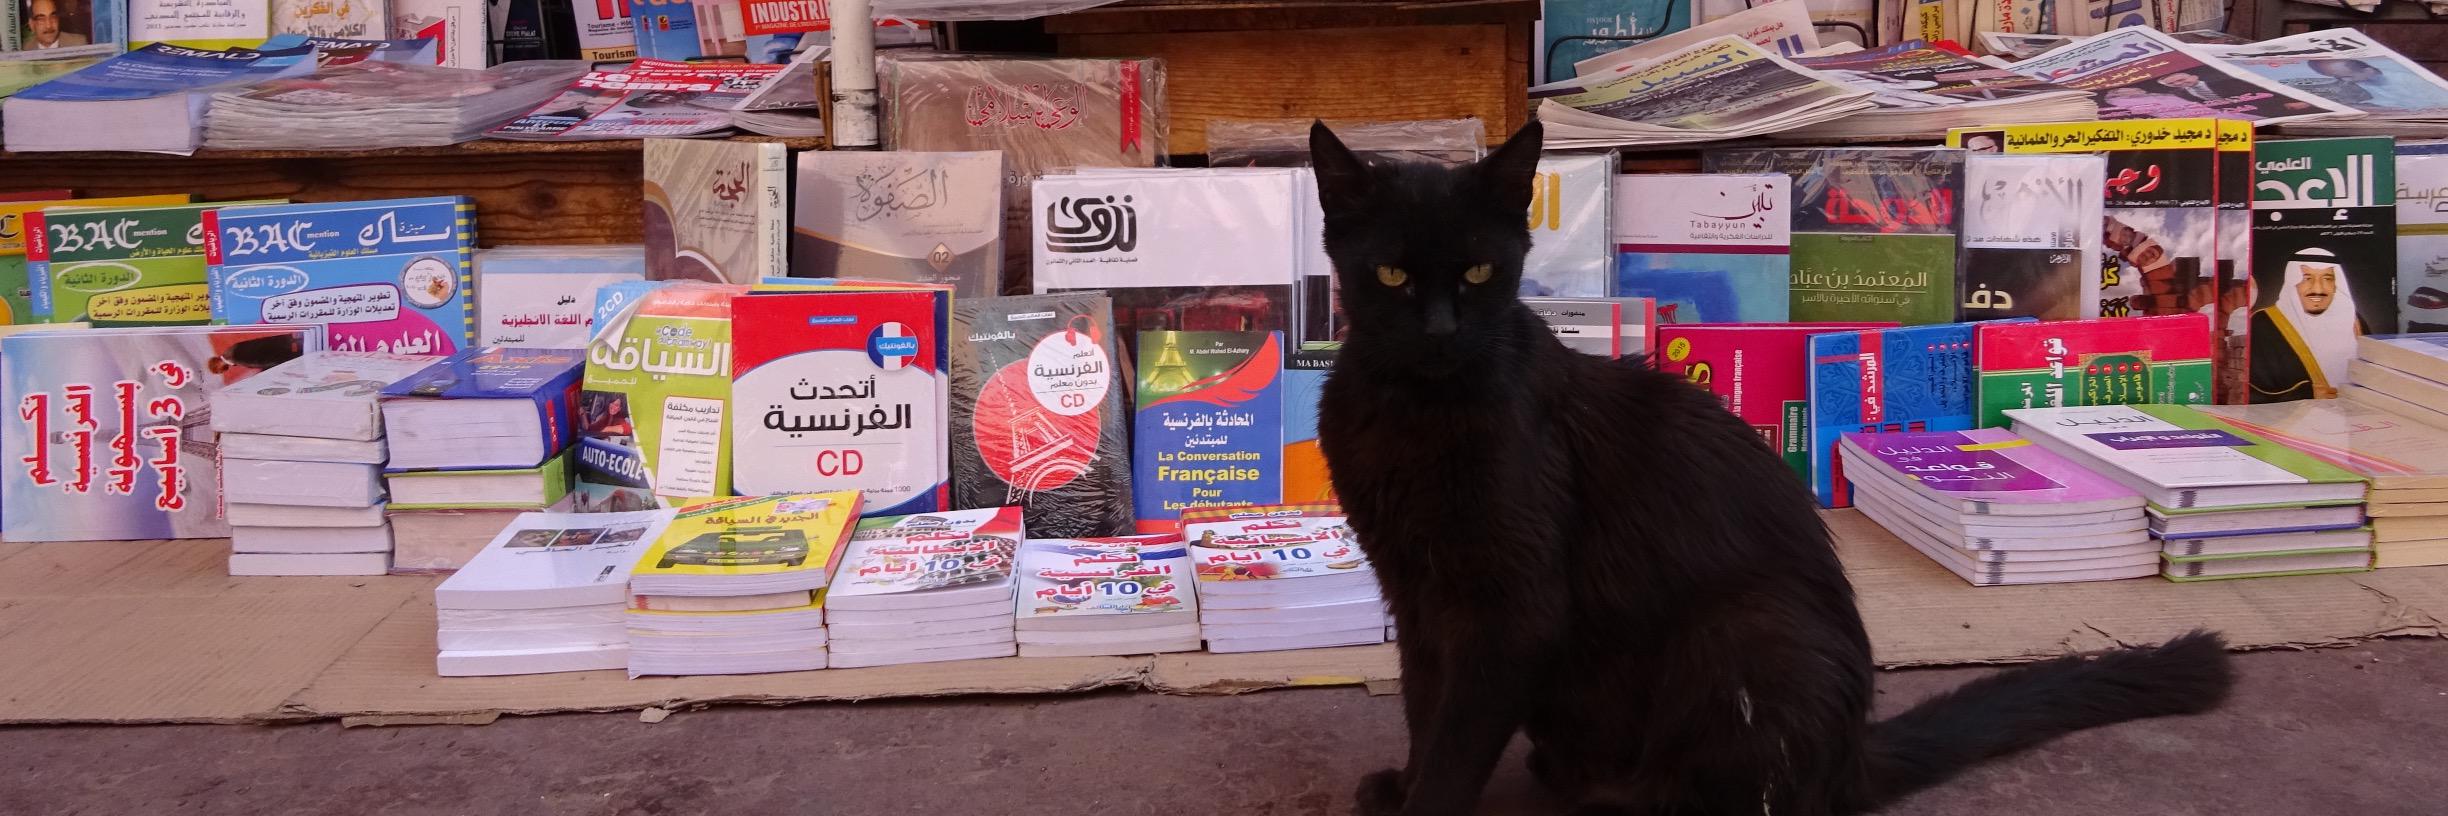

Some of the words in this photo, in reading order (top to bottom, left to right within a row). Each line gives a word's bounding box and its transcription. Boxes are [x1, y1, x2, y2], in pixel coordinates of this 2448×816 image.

[157, 45, 261, 60] REMALD
[592, 49, 638, 60] Tourism
[2173, 128, 2202, 141] مجيد
[2254, 156, 2312, 174] العلمي
[2252, 154, 2373, 221] الإعج
[1690, 220, 1746, 230] Tabayyun
[50, 217, 142, 253] BAC
[133, 229, 167, 237] mention
[226, 220, 317, 257] BAC
[306, 230, 340, 239] mention
[932, 252, 949, 264] 02
[63, 273, 97, 287] الثانية
[100, 271, 136, 284] الدورة
[232, 277, 265, 291] الثانية
[267, 273, 302, 288] الدورة
[167, 292, 194, 303] المنهجية
[339, 294, 366, 305] المنهجية
[368, 290, 391, 302] تطوير
[557, 295, 576, 306] دليل
[1896, 295, 1910, 307] في
[162, 304, 190, 316] الوزارة
[337, 306, 363, 318] الوزارة
[365, 303, 396, 314] تعديلات
[597, 290, 625, 320] 2CD
[93, 307, 124, 319] الرسمية
[268, 309, 298, 322] الرسمية
[299, 308, 335, 320] للمقررات
[554, 314, 581, 326] اللغة
[968, 330, 1016, 342] بالفونتيك
[878, 341, 916, 351] بالفونتيك
[1672, 342, 1688, 358] 2015
[1296, 359, 1311, 368] MA
[1732, 349, 1743, 381] française
[2042, 337, 2068, 379] قواعد
[151, 362, 191, 387] في
[1033, 361, 1103, 379] الفرنسية
[1859, 352, 1876, 394] المرشد
[789, 374, 876, 401] أتحدث
[1050, 380, 1074, 390] معلم
[1075, 379, 1097, 388] بدون
[1733, 381, 1743, 405] langue
[2044, 383, 2063, 408] اللغ
[150, 398, 183, 417] 3
[1060, 393, 1085, 408] CD
[763, 403, 912, 438] الفرنسية
[1163, 411, 1213, 431] بالفرنسية
[1215, 410, 1254, 427] المحادثة
[2055, 415, 2154, 427] الدليل
[1787, 406, 1799, 453] Grammaire
[20, 394, 57, 485] تكلم
[65, 385, 98, 493] الفرنسية
[107, 382, 143, 493] بسهولة
[1158, 451, 1173, 461] La
[1177, 451, 1261, 461] Conversation
[1878, 445, 1953, 456] الدليل
[582, 446, 644, 481] AUTO-ECOLE
[816, 449, 864, 477] CD
[1905, 461, 1996, 472] قواعد
[1158, 465, 1260, 485] Française
[1922, 471, 2015, 483] النحو
[1192, 487, 1222, 498] Pour
[1163, 500, 1185, 511] Les
[1189, 500, 1254, 509] débutants
[1241, 519, 1302, 533] تكلم
[906, 531, 970, 545] تكلم
[1272, 547, 1312, 561] 10
[1323, 545, 1351, 559] في
[925, 559, 960, 572] 10
[965, 555, 999, 569] في
[1073, 553, 1138, 567] تكلم
[1039, 565, 1171, 581] الفرنسية
[1100, 582, 1139, 596] 10
[1145, 580, 1176, 597] في
